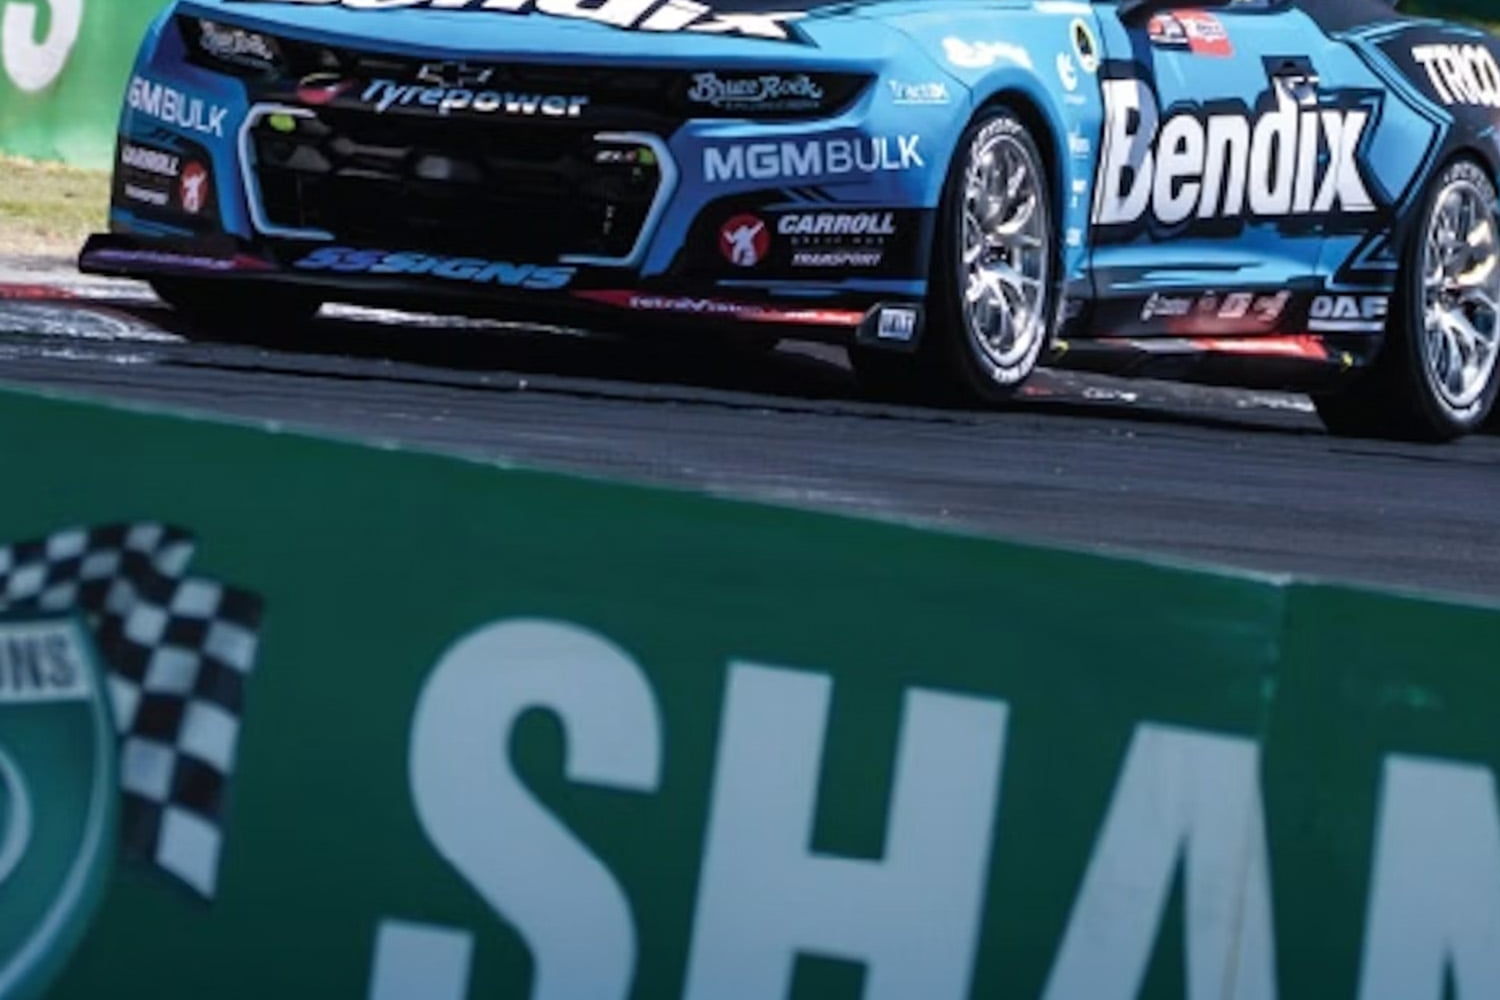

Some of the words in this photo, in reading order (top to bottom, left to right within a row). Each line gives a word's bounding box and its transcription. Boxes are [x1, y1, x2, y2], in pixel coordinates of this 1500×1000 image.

[361, 77, 589, 116] Tyrepower
[703, 134, 925, 182] MGMBULK
[1090, 76, 1377, 225] Bendix
[777, 212, 898, 235] CARROLL
[1308, 296, 1389, 319] DAF
